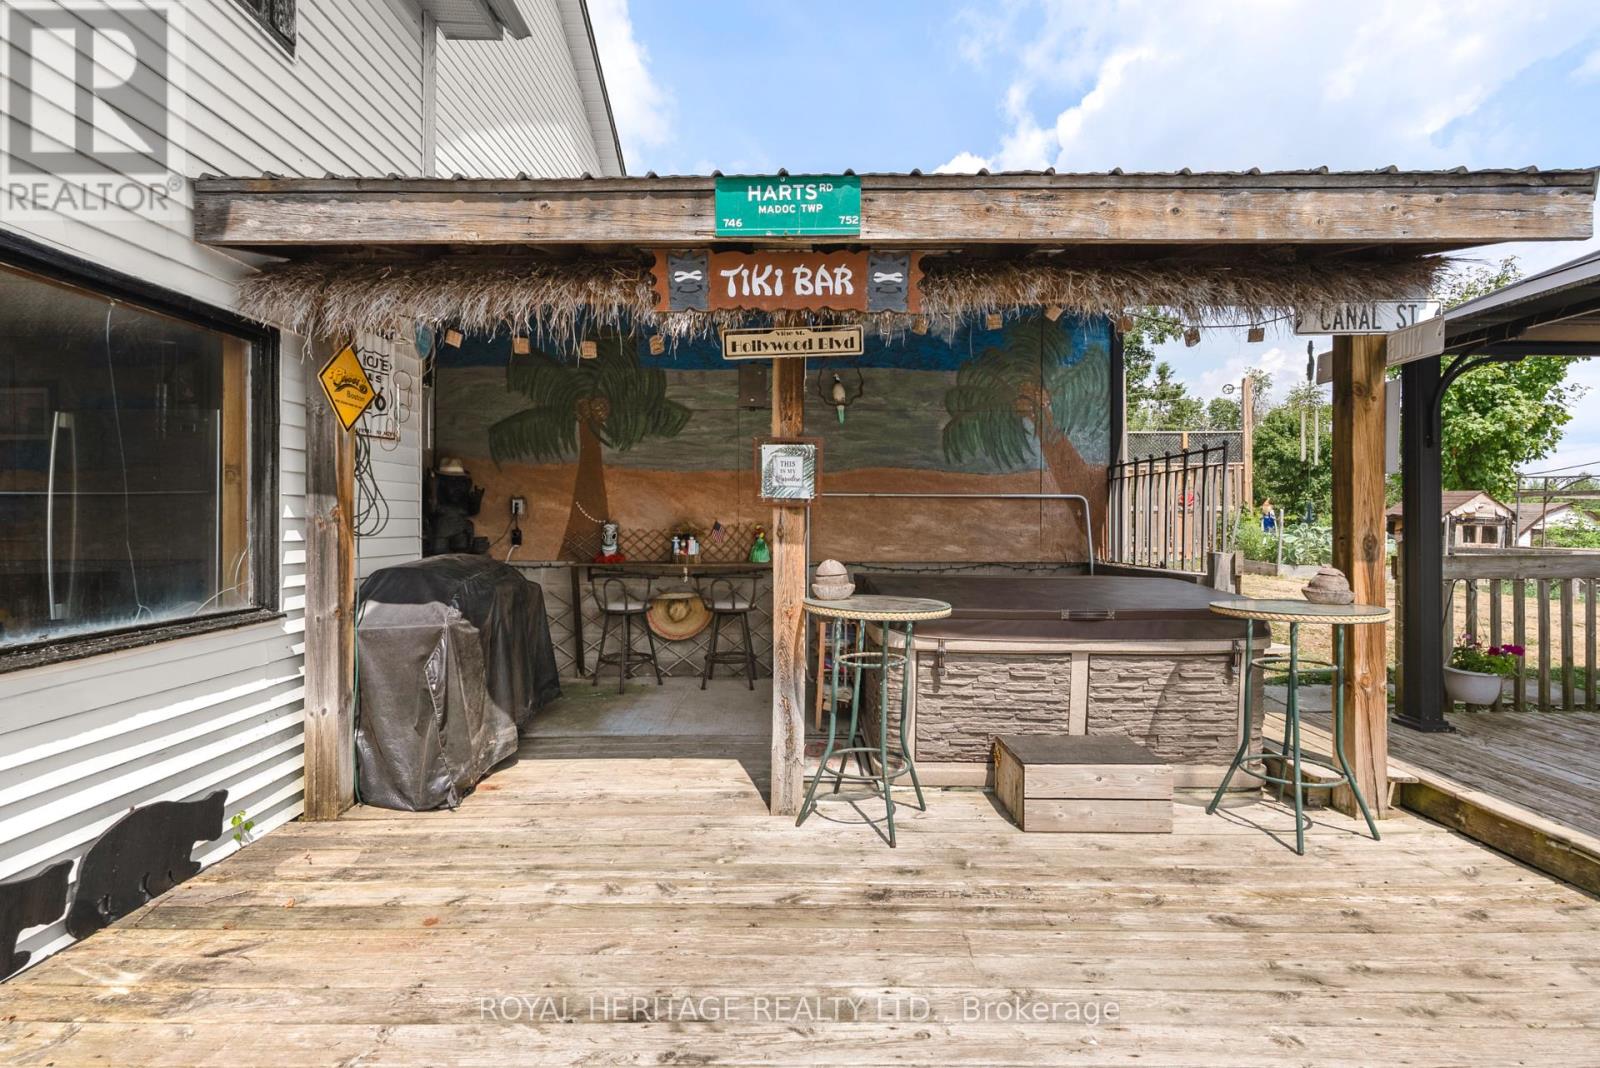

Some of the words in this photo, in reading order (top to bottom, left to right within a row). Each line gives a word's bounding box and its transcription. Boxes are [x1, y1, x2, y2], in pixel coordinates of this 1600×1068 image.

[748, 184, 817, 202] HARTS
[819, 183, 833, 192] RD
[758, 204, 796, 214] MADOC
[801, 203, 823, 213] TWP
[723, 218, 743, 228] 746
[839, 215, 859, 225] 752
[720, 264, 783, 297] TIKI
[792, 264, 854, 296] BAR
[1320, 305, 1382, 331] CANAL
[1396, 304, 1418, 329] ST
[731, 338, 813, 353] Hollywood
[818, 335, 855, 350] Blvd
[780, 460, 796, 468] THIS
